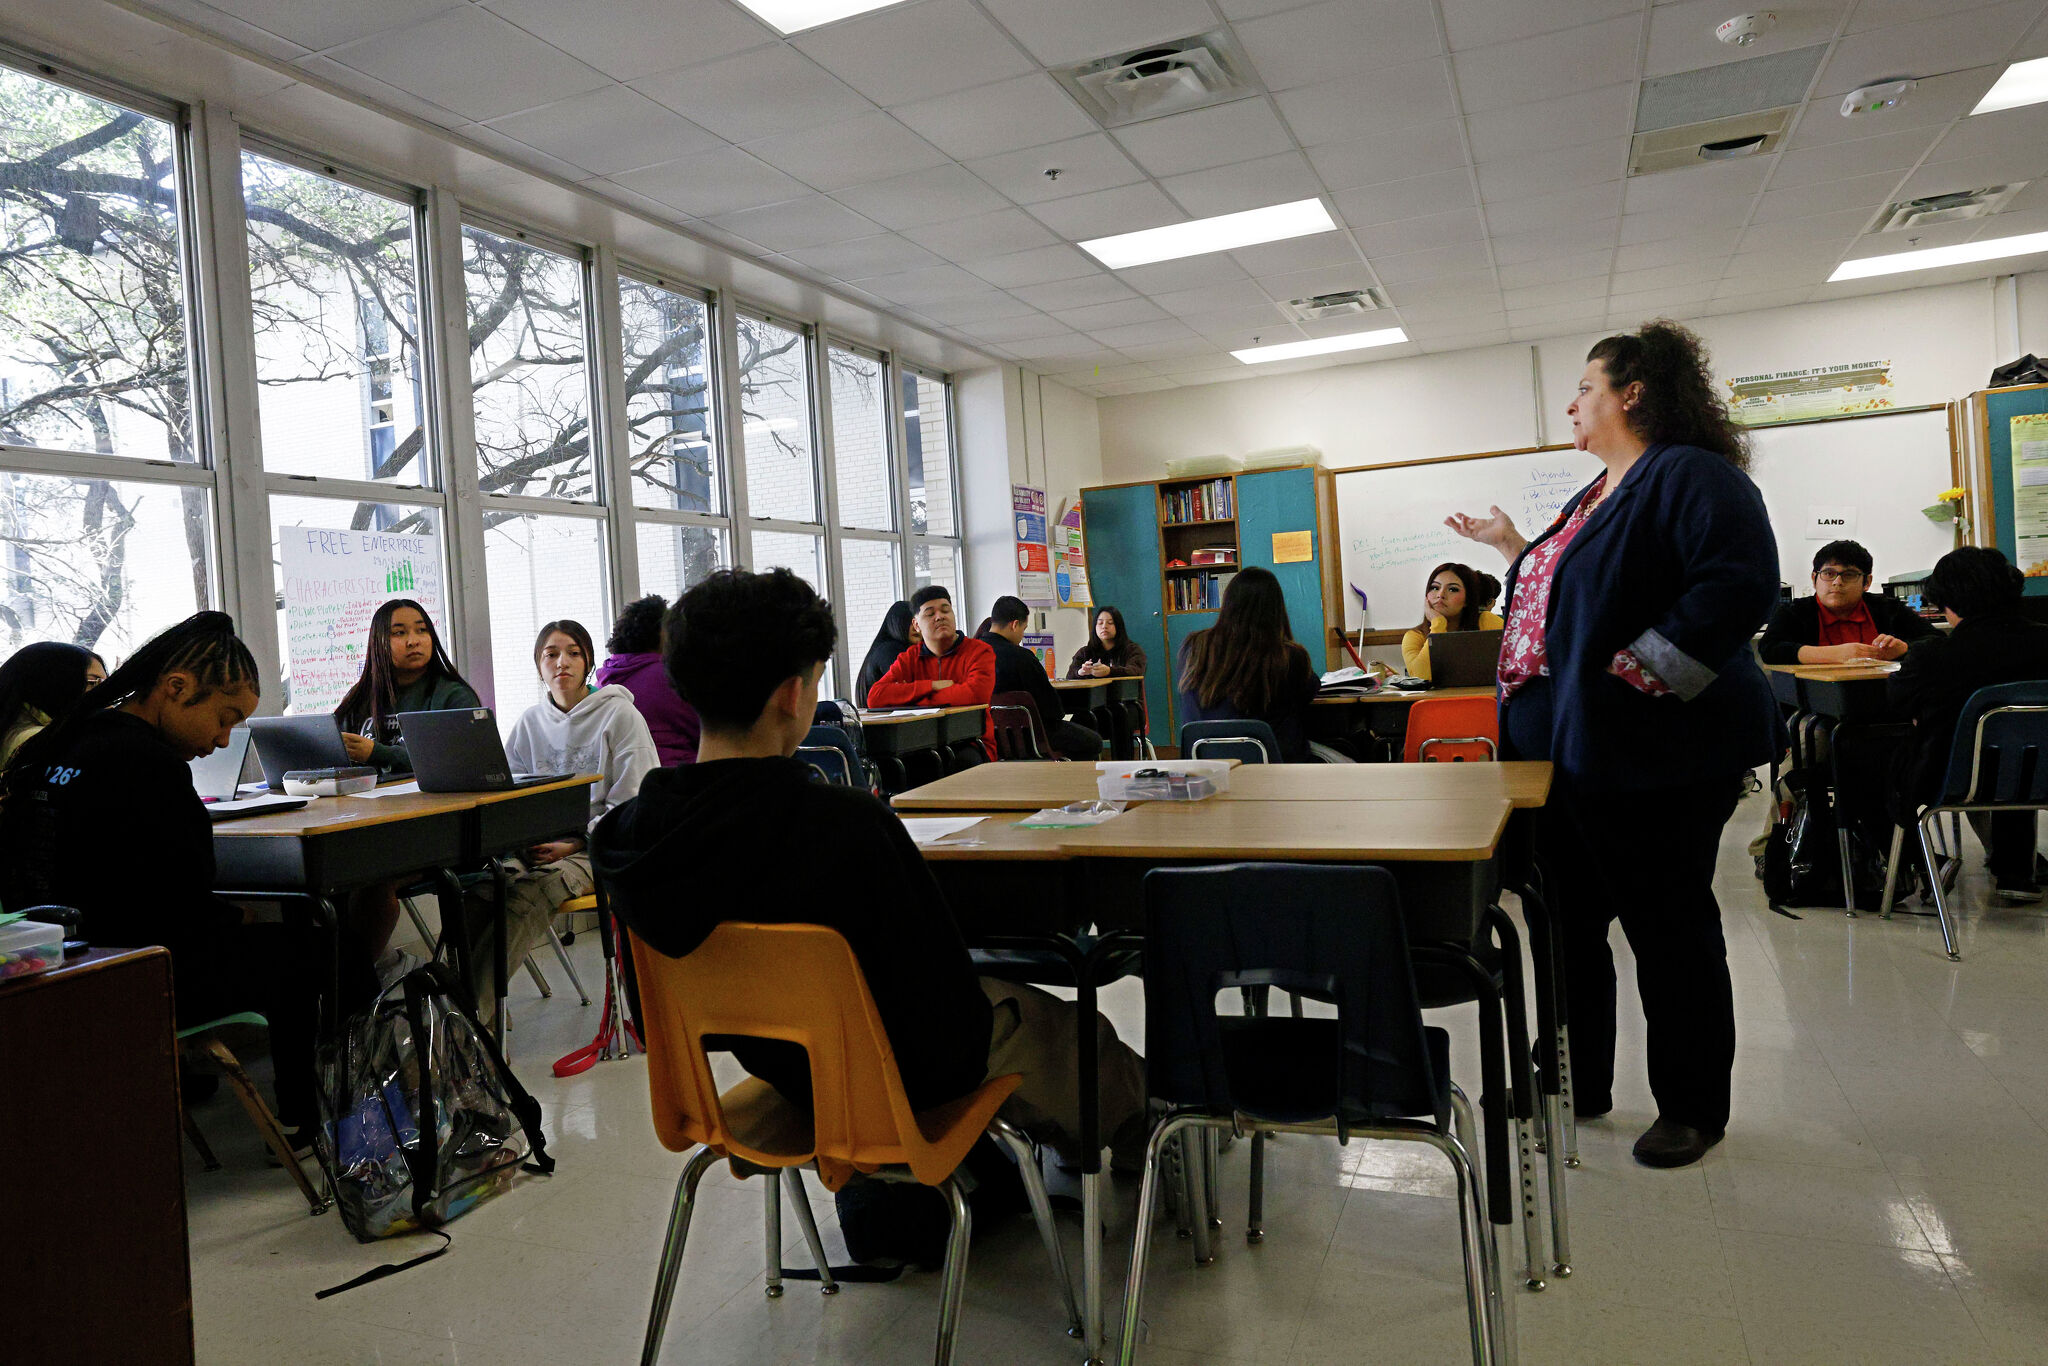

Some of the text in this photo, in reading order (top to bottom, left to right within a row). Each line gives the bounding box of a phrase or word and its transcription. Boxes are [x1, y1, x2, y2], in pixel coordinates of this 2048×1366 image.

[1735, 374, 1773, 383] PERSONAL
[1776, 369, 1809, 379] FINANCE:
[1829, 364, 1849, 372] YOUR
[307, 530, 425, 555] FREE ENTERPRISE
